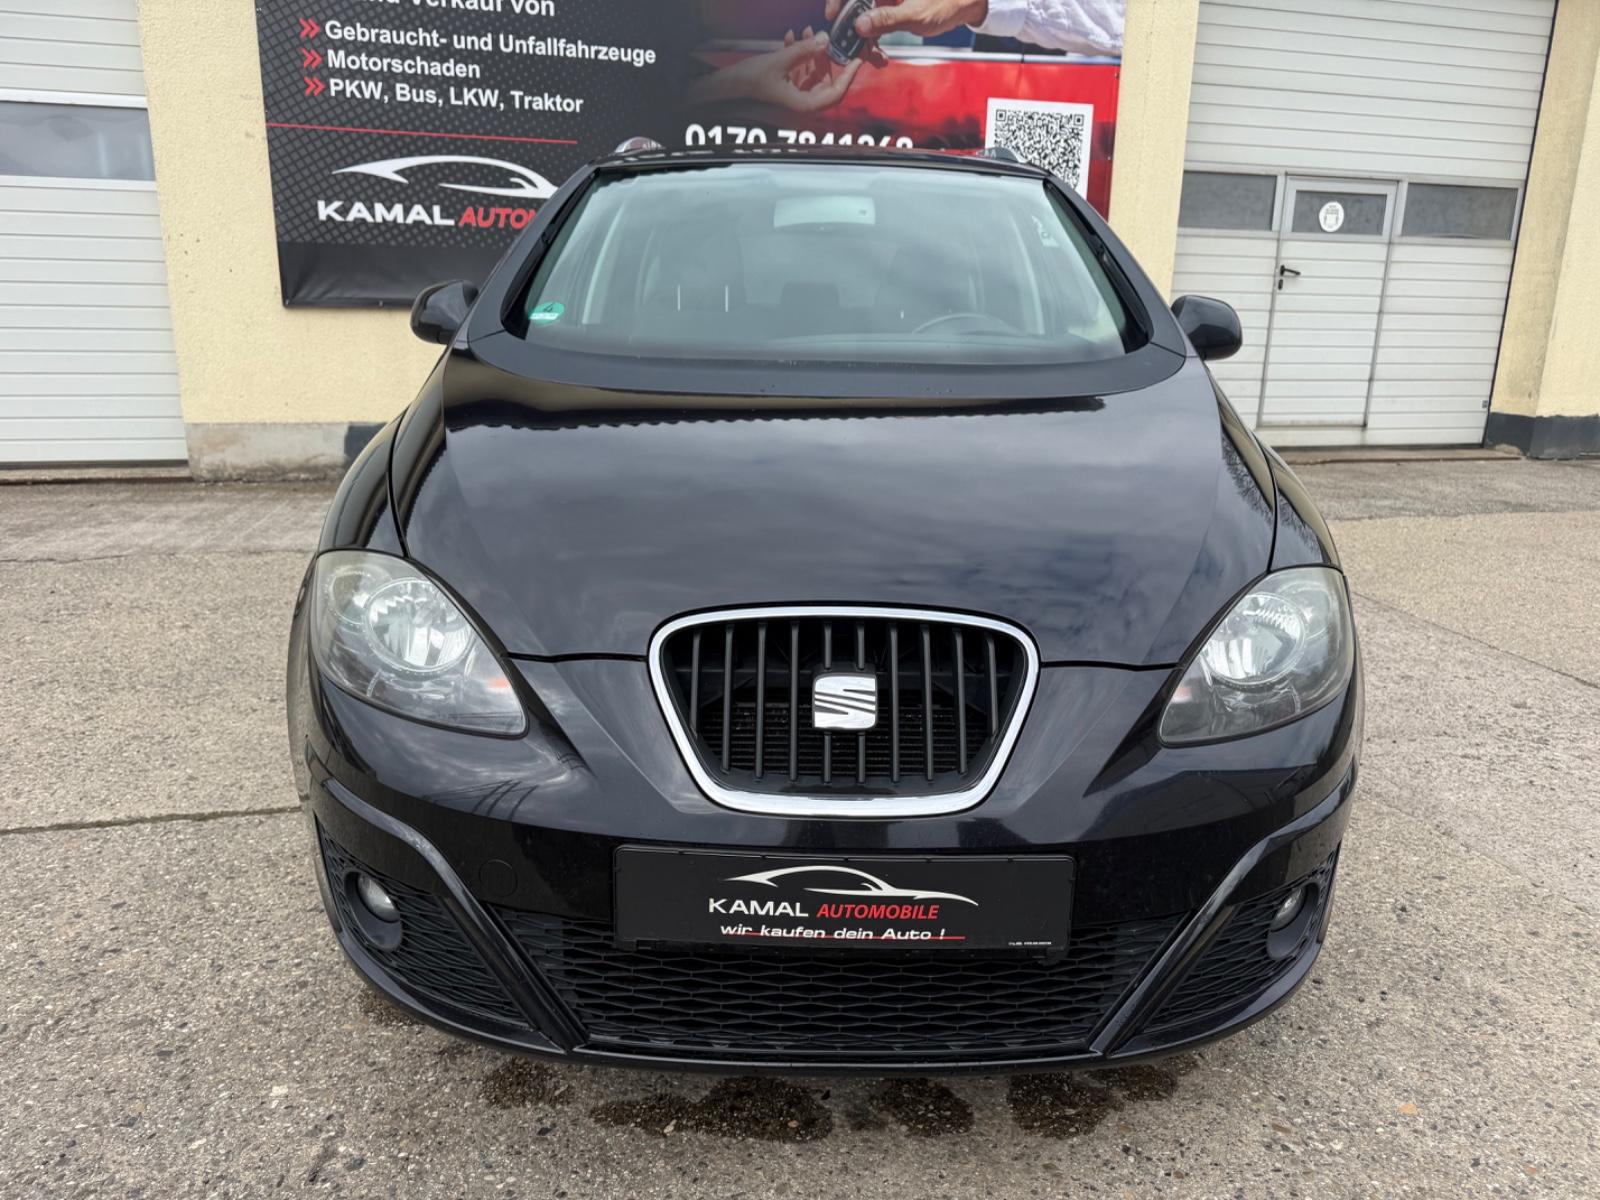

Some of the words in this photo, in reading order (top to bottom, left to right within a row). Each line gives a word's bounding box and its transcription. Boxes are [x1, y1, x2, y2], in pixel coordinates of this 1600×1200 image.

[510, 0, 556, 17] von
[325, 20, 448, 48] Gebraucht-
[453, 32, 493, 52] und
[499, 34, 657, 66] Unfallfahrzeuge
[327, 49, 481, 79] Motorschaden
[329, 77, 389, 103] PKW,
[395, 82, 444, 107] Bus,
[449, 86, 504, 110] LKW,
[510, 89, 584, 113] Traktor
[316, 199, 456, 227] KAMAL
[458, 206, 536, 230] AUTO
[708, 898, 809, 918] KAMAL
[816, 904, 940, 920] AUTOMOBILE
[720, 923, 753, 937] wir
[760, 925, 825, 940] kaufen
[833, 927, 874, 940] dein
[881, 928, 931, 941] Auto
[939, 928, 946, 941] !
